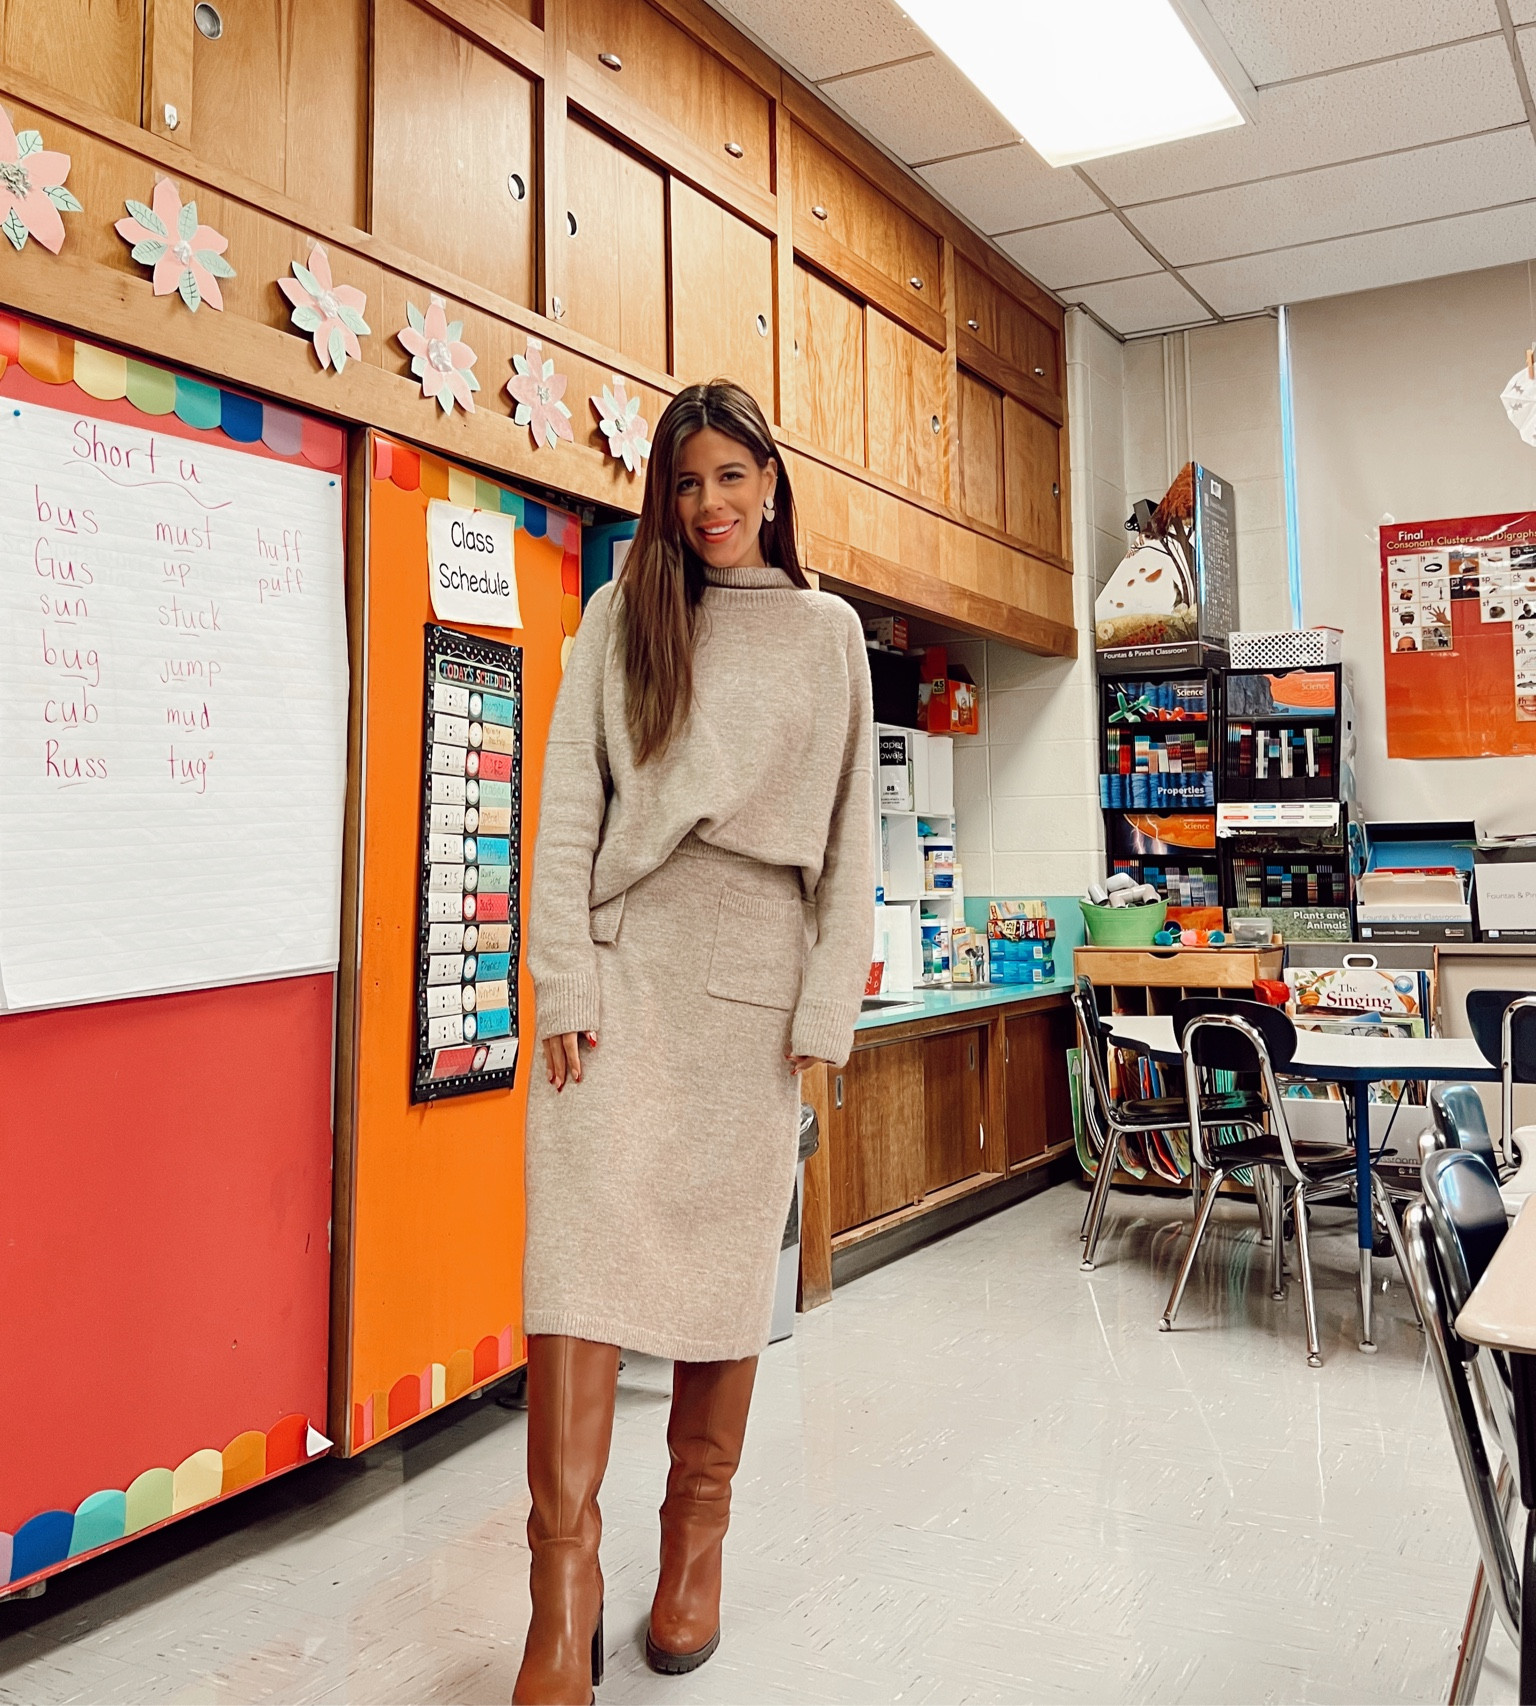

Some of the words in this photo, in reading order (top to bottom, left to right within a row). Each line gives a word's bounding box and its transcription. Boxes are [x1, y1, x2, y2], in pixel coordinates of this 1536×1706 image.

[73, 420, 160, 474] Short
[180, 460, 201, 484] u
[36, 485, 98, 534] bus
[156, 516, 212, 550] must
[451, 521, 494, 553] Class
[1386, 538, 1434, 550] Consonant
[1437, 537, 1474, 546] Clusters
[1398, 530, 1424, 541] Final
[257, 529, 302, 563] huff
[1511, 548, 1521, 556] ch
[35, 537, 94, 585] Gus
[163, 562, 191, 587] up
[259, 569, 303, 603] puff
[439, 563, 510, 597] Schedule
[1421, 580, 1433, 588] mp
[40, 594, 88, 617] sun
[158, 595, 221, 631] stuck
[1515, 623, 1525, 631] ng
[42, 630, 100, 687] bug
[1104, 651, 1128, 660] Fountas
[1134, 649, 1155, 657] Pinnell
[1155, 647, 1188, 656] Classroom
[1516, 647, 1526, 656] ph
[160, 659, 222, 687] jump
[441, 662, 474, 683] TODAY'S
[476, 669, 511, 690] SCHEDULE
[1176, 688, 1204, 697] Science
[1301, 682, 1330, 690] Science
[45, 686, 99, 724] cub
[167, 702, 210, 728] mud
[46, 739, 108, 780] Russ
[168, 745, 207, 794] tug
[1157, 786, 1205, 796] Properties
[1183, 822, 1211, 830] Science
[1293, 911, 1325, 919] Plants
[1326, 911, 1346, 919] and
[1306, 921, 1348, 930] Animals
[1362, 913, 1390, 921] Fountas
[1338, 984, 1358, 992] The
[1326, 991, 1393, 1012] Singing
